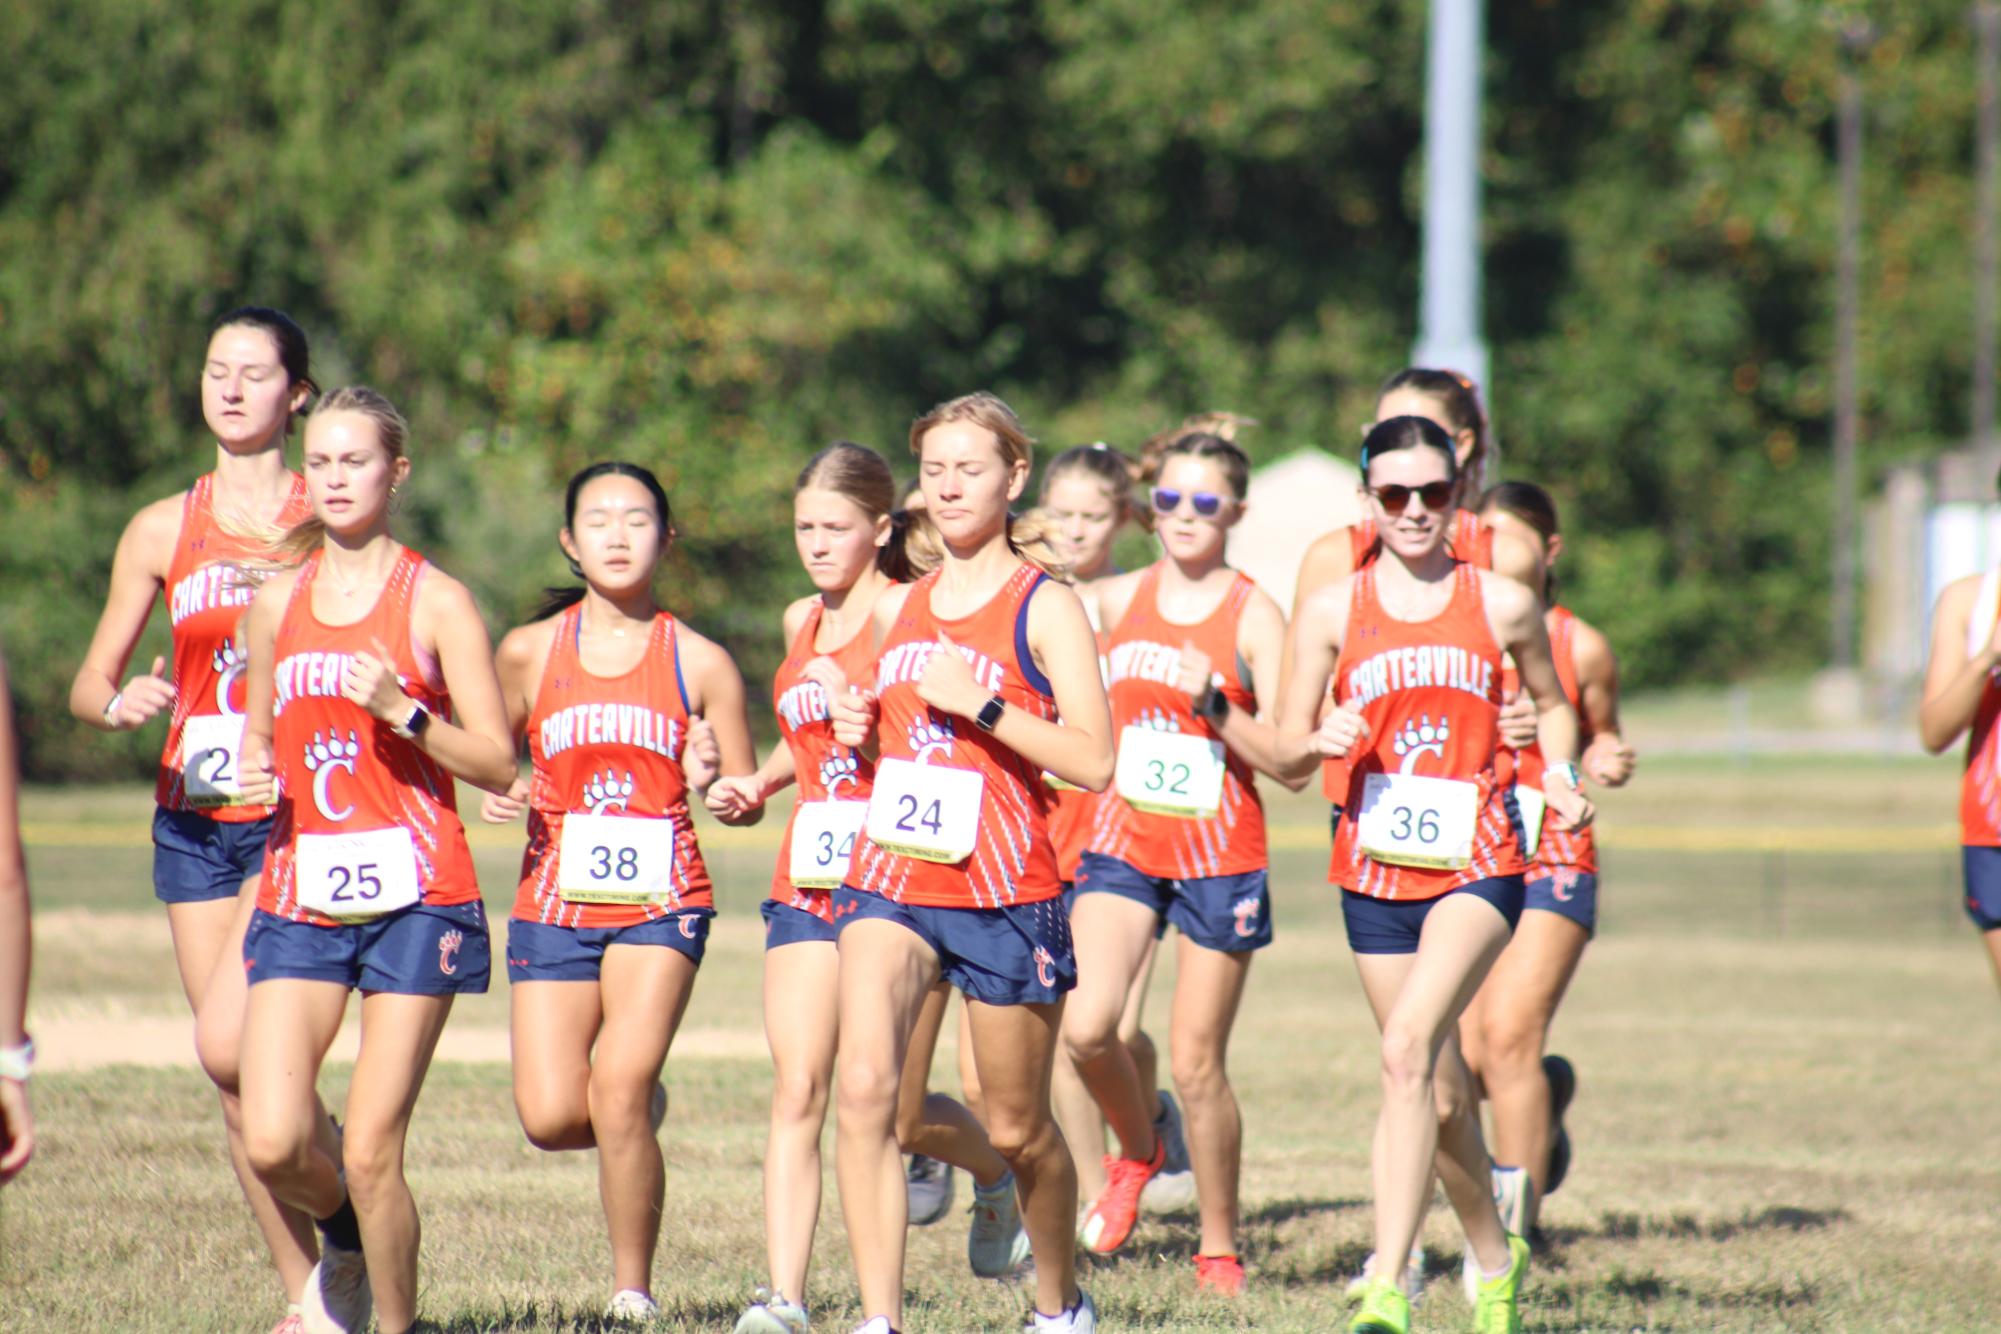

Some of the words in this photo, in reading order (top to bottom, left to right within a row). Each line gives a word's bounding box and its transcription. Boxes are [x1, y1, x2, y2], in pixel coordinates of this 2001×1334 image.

[1349, 645, 1493, 709] CARTERVILLE
[541, 703, 679, 761] CARTERVILLE
[207, 747, 239, 783] 2
[1144, 760, 1190, 795] 32
[895, 794, 942, 835] 24
[1390, 806, 1440, 844] 36
[589, 846, 638, 881] 38
[816, 831, 857, 866] 34
[328, 863, 382, 902] 25
